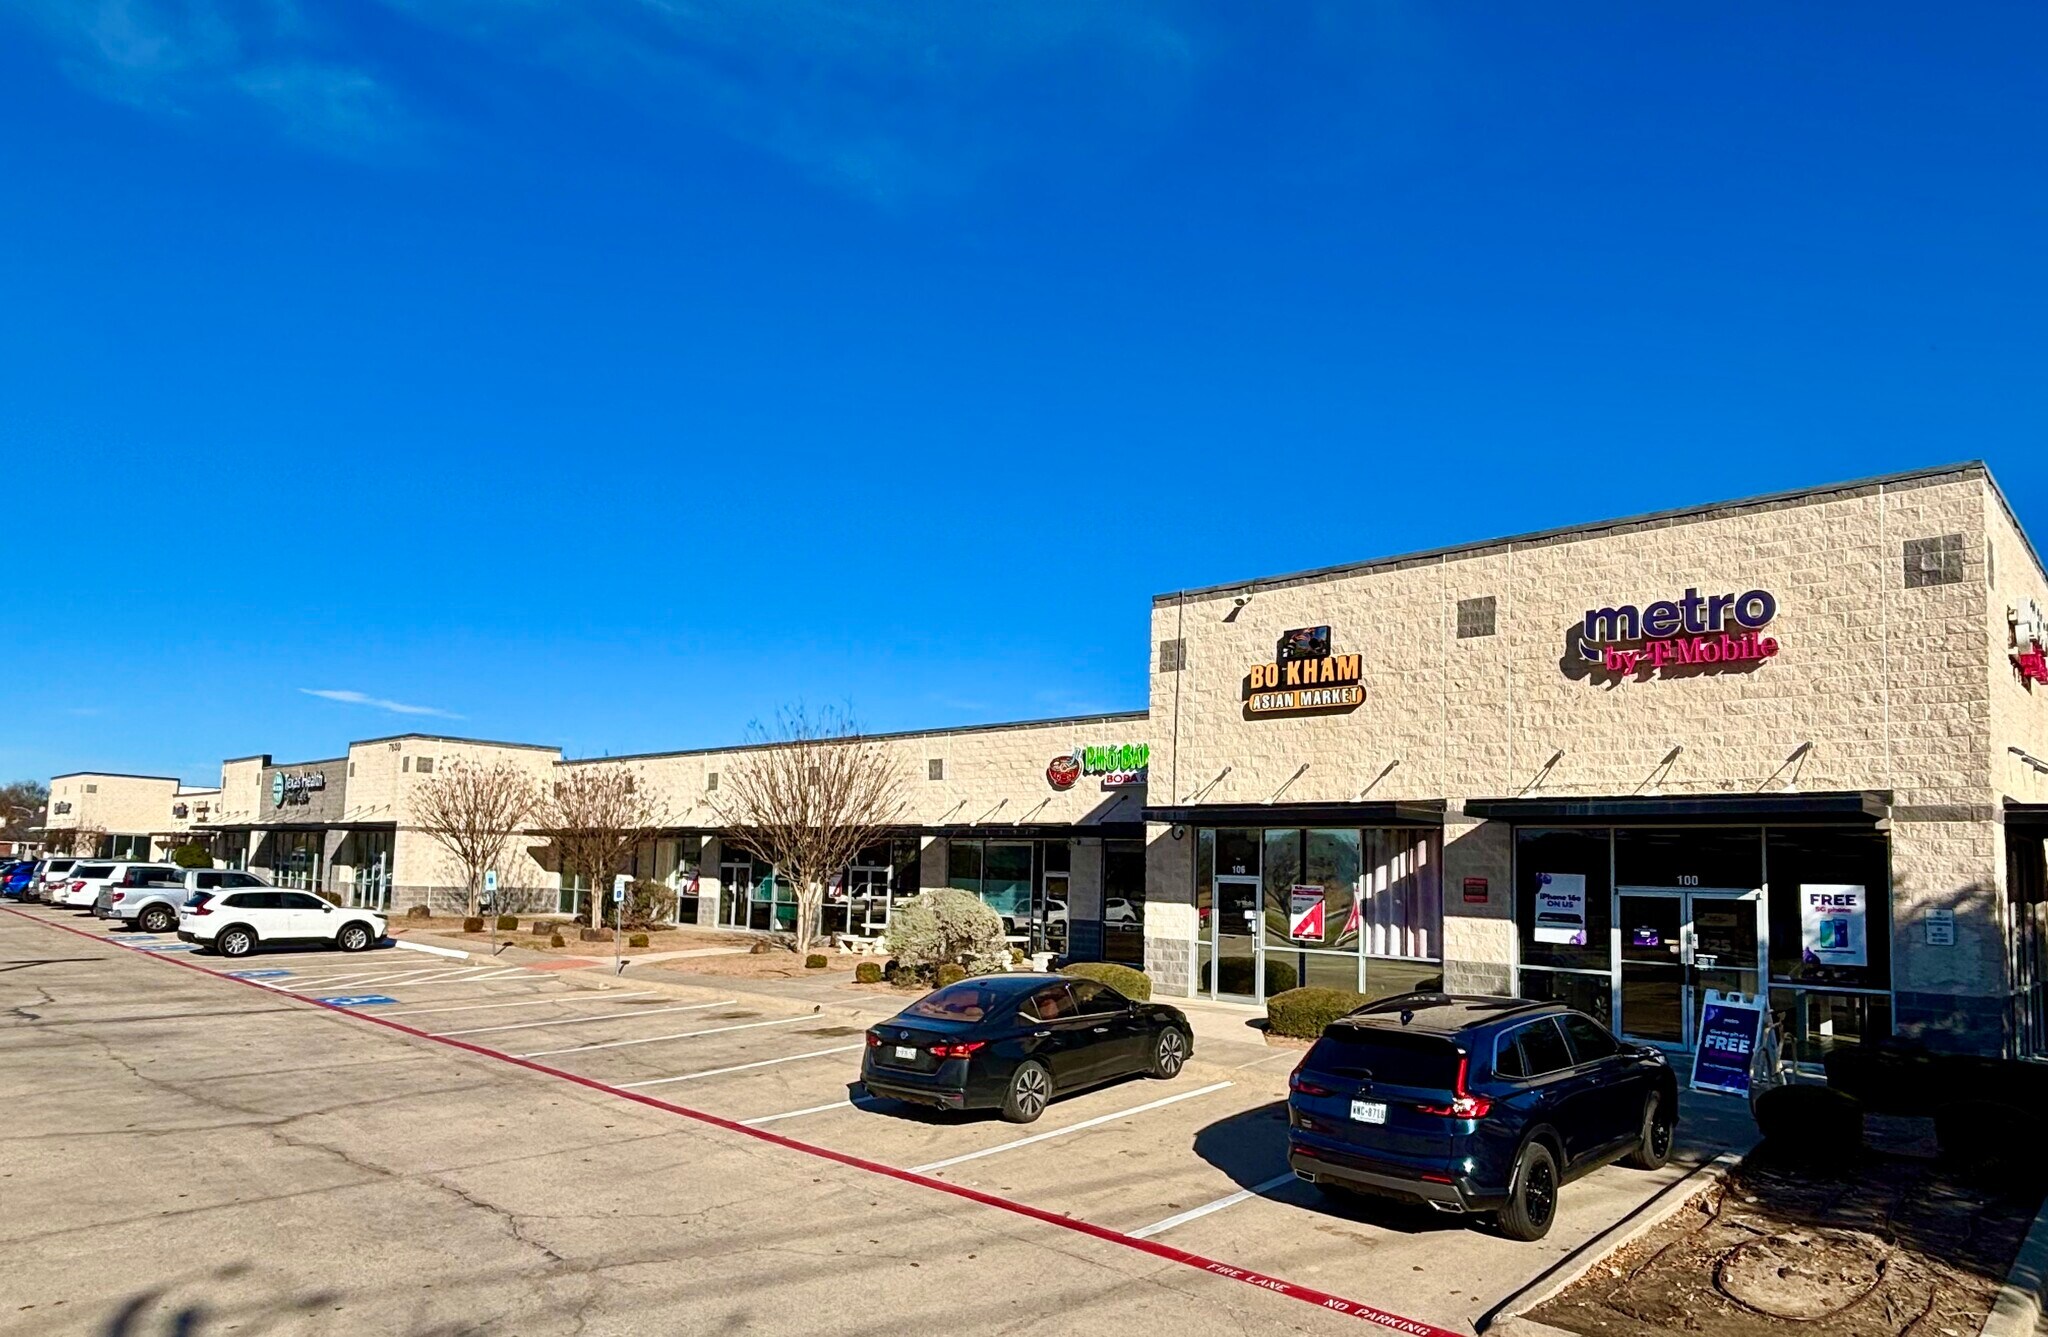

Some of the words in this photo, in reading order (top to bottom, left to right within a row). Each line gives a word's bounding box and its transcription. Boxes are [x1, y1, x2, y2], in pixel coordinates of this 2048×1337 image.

[1584, 587, 1777, 642] metro
[1605, 645, 1637, 676] by
[1250, 663, 1279, 690] BO
[1286, 654, 1359, 686] KHAM
[1252, 692, 1294, 710] ASIAN
[1300, 686, 1359, 707] MARKET
[1106, 773, 1140, 784] BOBA
[1676, 875, 1699, 886] 100
[1539, 892, 1567, 901] iPhone
[1547, 900, 1561, 908] ON
[1562, 900, 1574, 909] US
[1810, 893, 1857, 906] FREE
[1827, 906, 1853, 915] phone
[1704, 1034, 1751, 1055] FREE
[1206, 1263, 1244, 1278] FIRE
[1246, 1275, 1291, 1292] LANE
[1323, 1298, 1350, 1311] NO
[1354, 1308, 1431, 1336] PARKING
